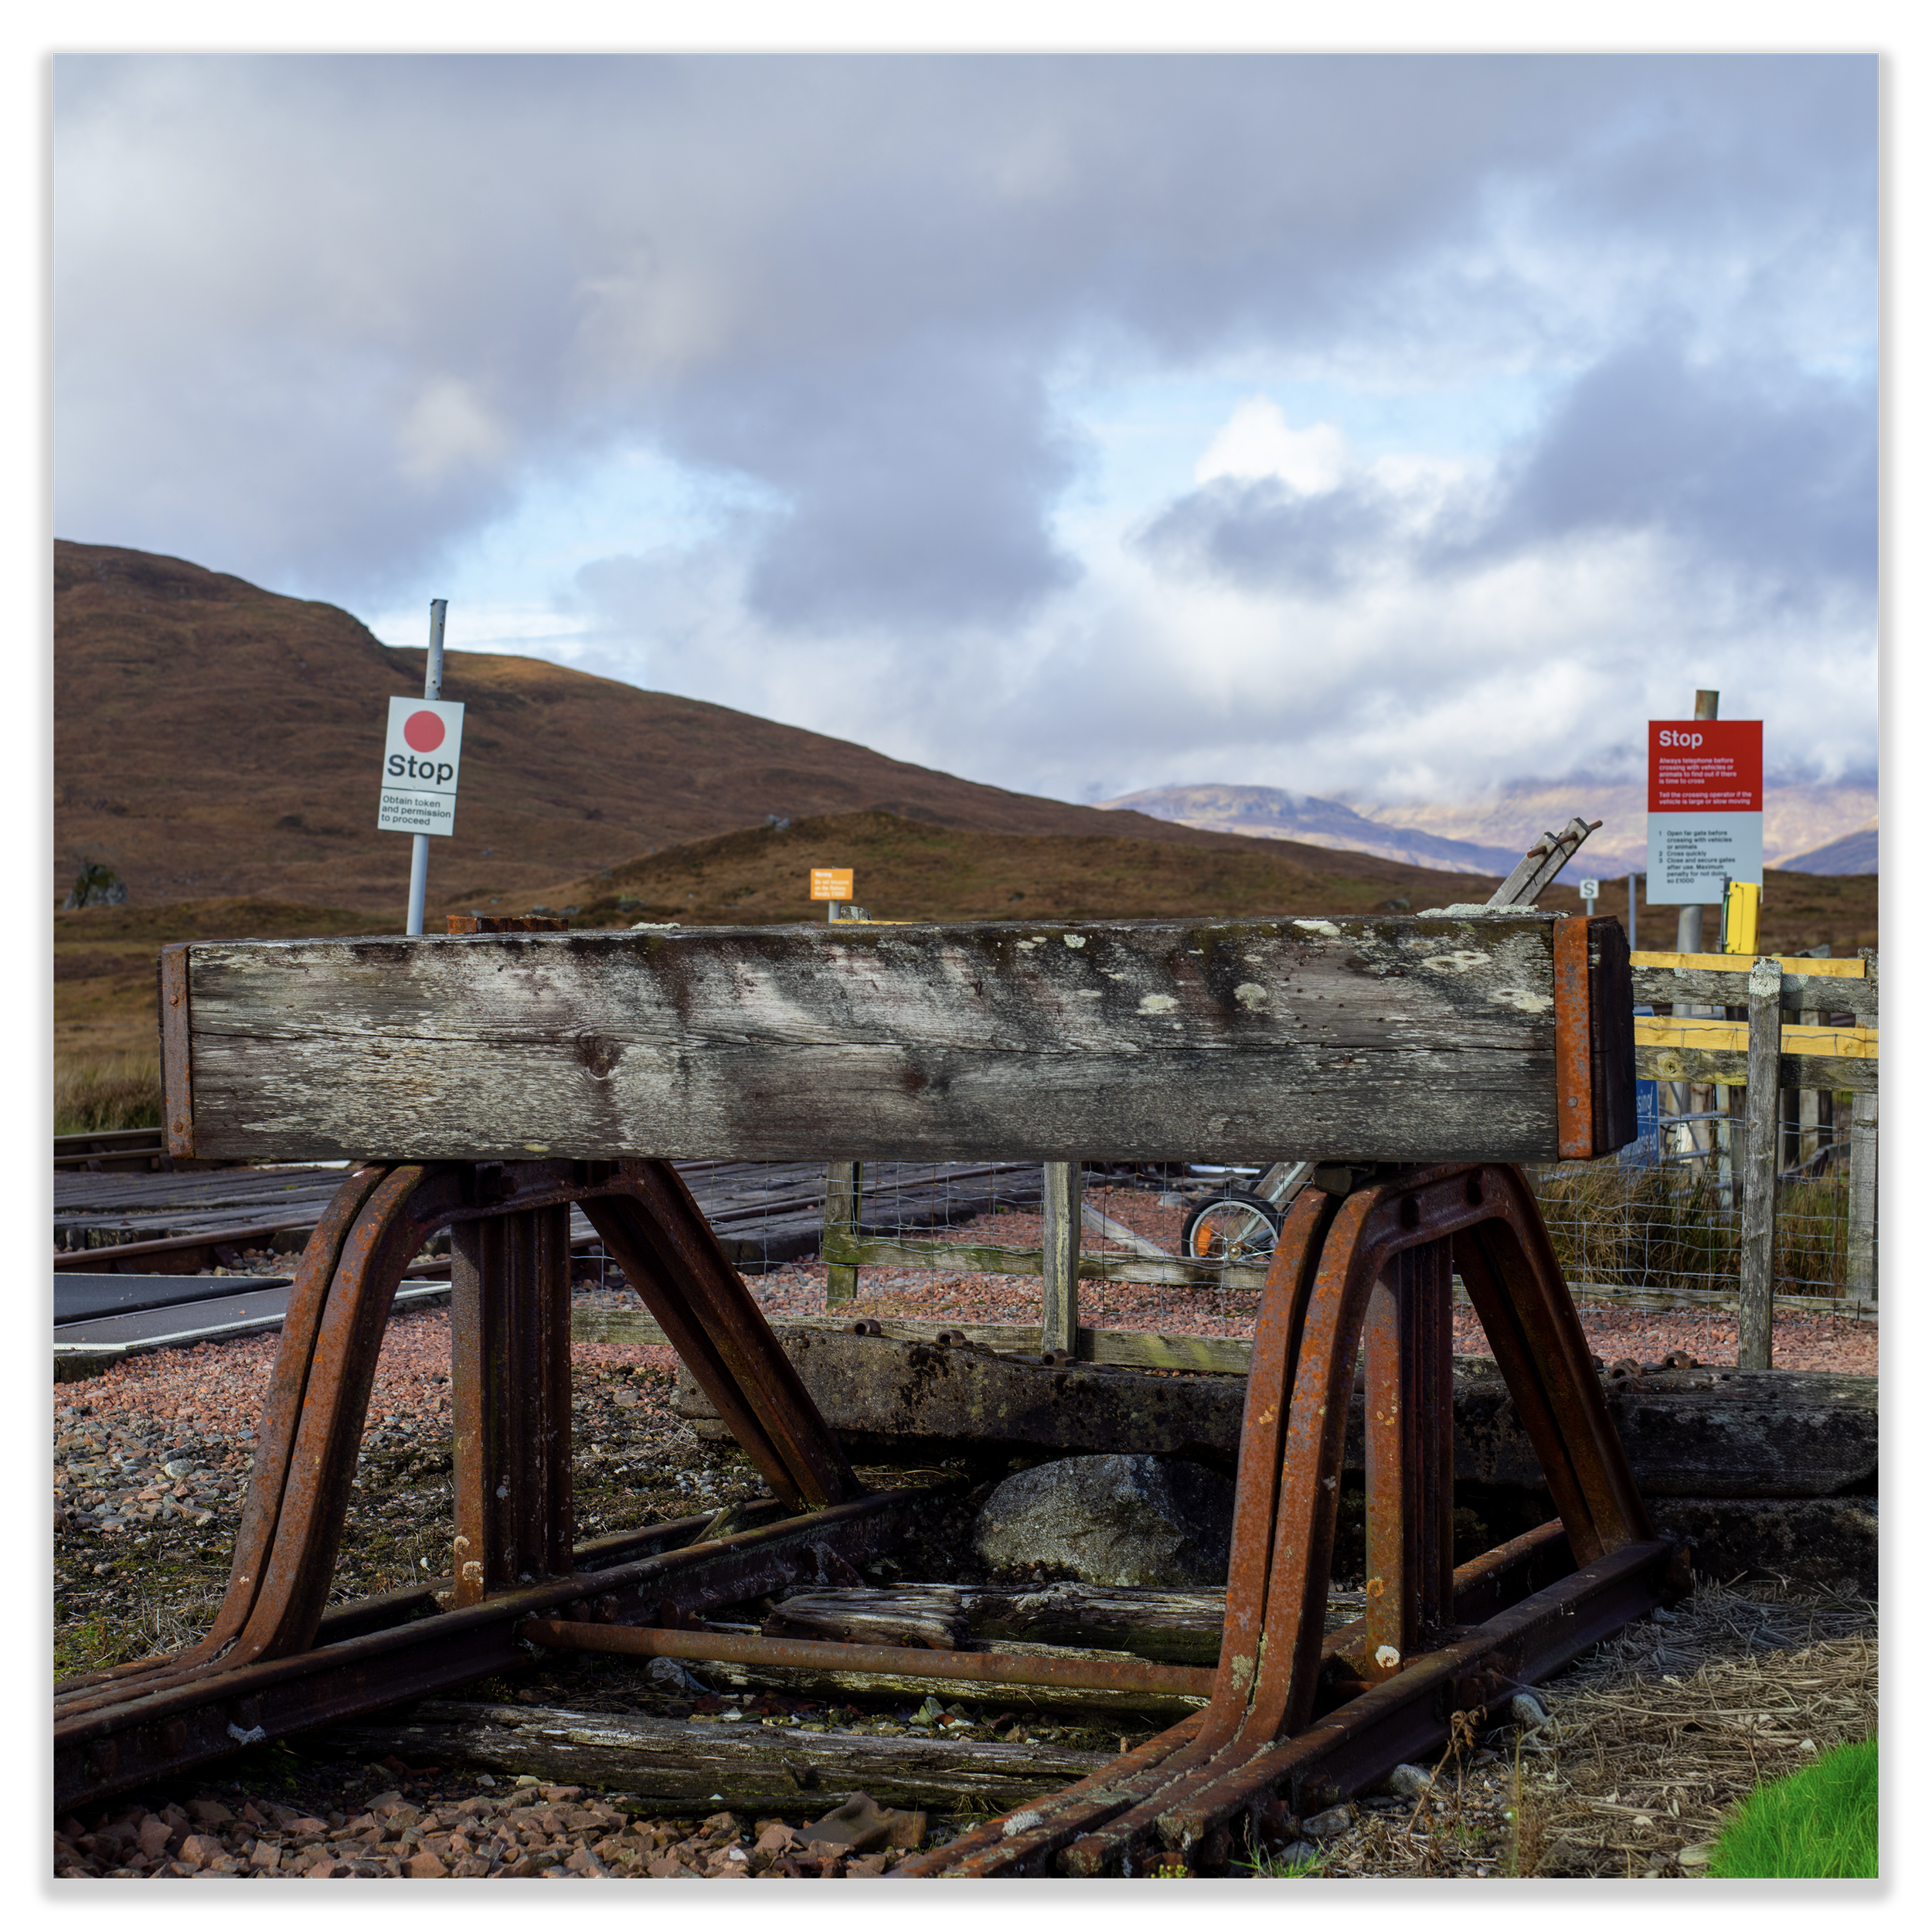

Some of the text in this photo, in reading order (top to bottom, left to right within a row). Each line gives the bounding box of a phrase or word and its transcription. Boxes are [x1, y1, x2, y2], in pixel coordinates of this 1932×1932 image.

[1659, 730, 1702, 749] Stop
[387, 754, 454, 784] Stop
[383, 795, 440, 808] Obtain token
[401, 807, 451, 818] permission
[393, 816, 430, 825] proceed
[1584, 882, 1594, 896] S
